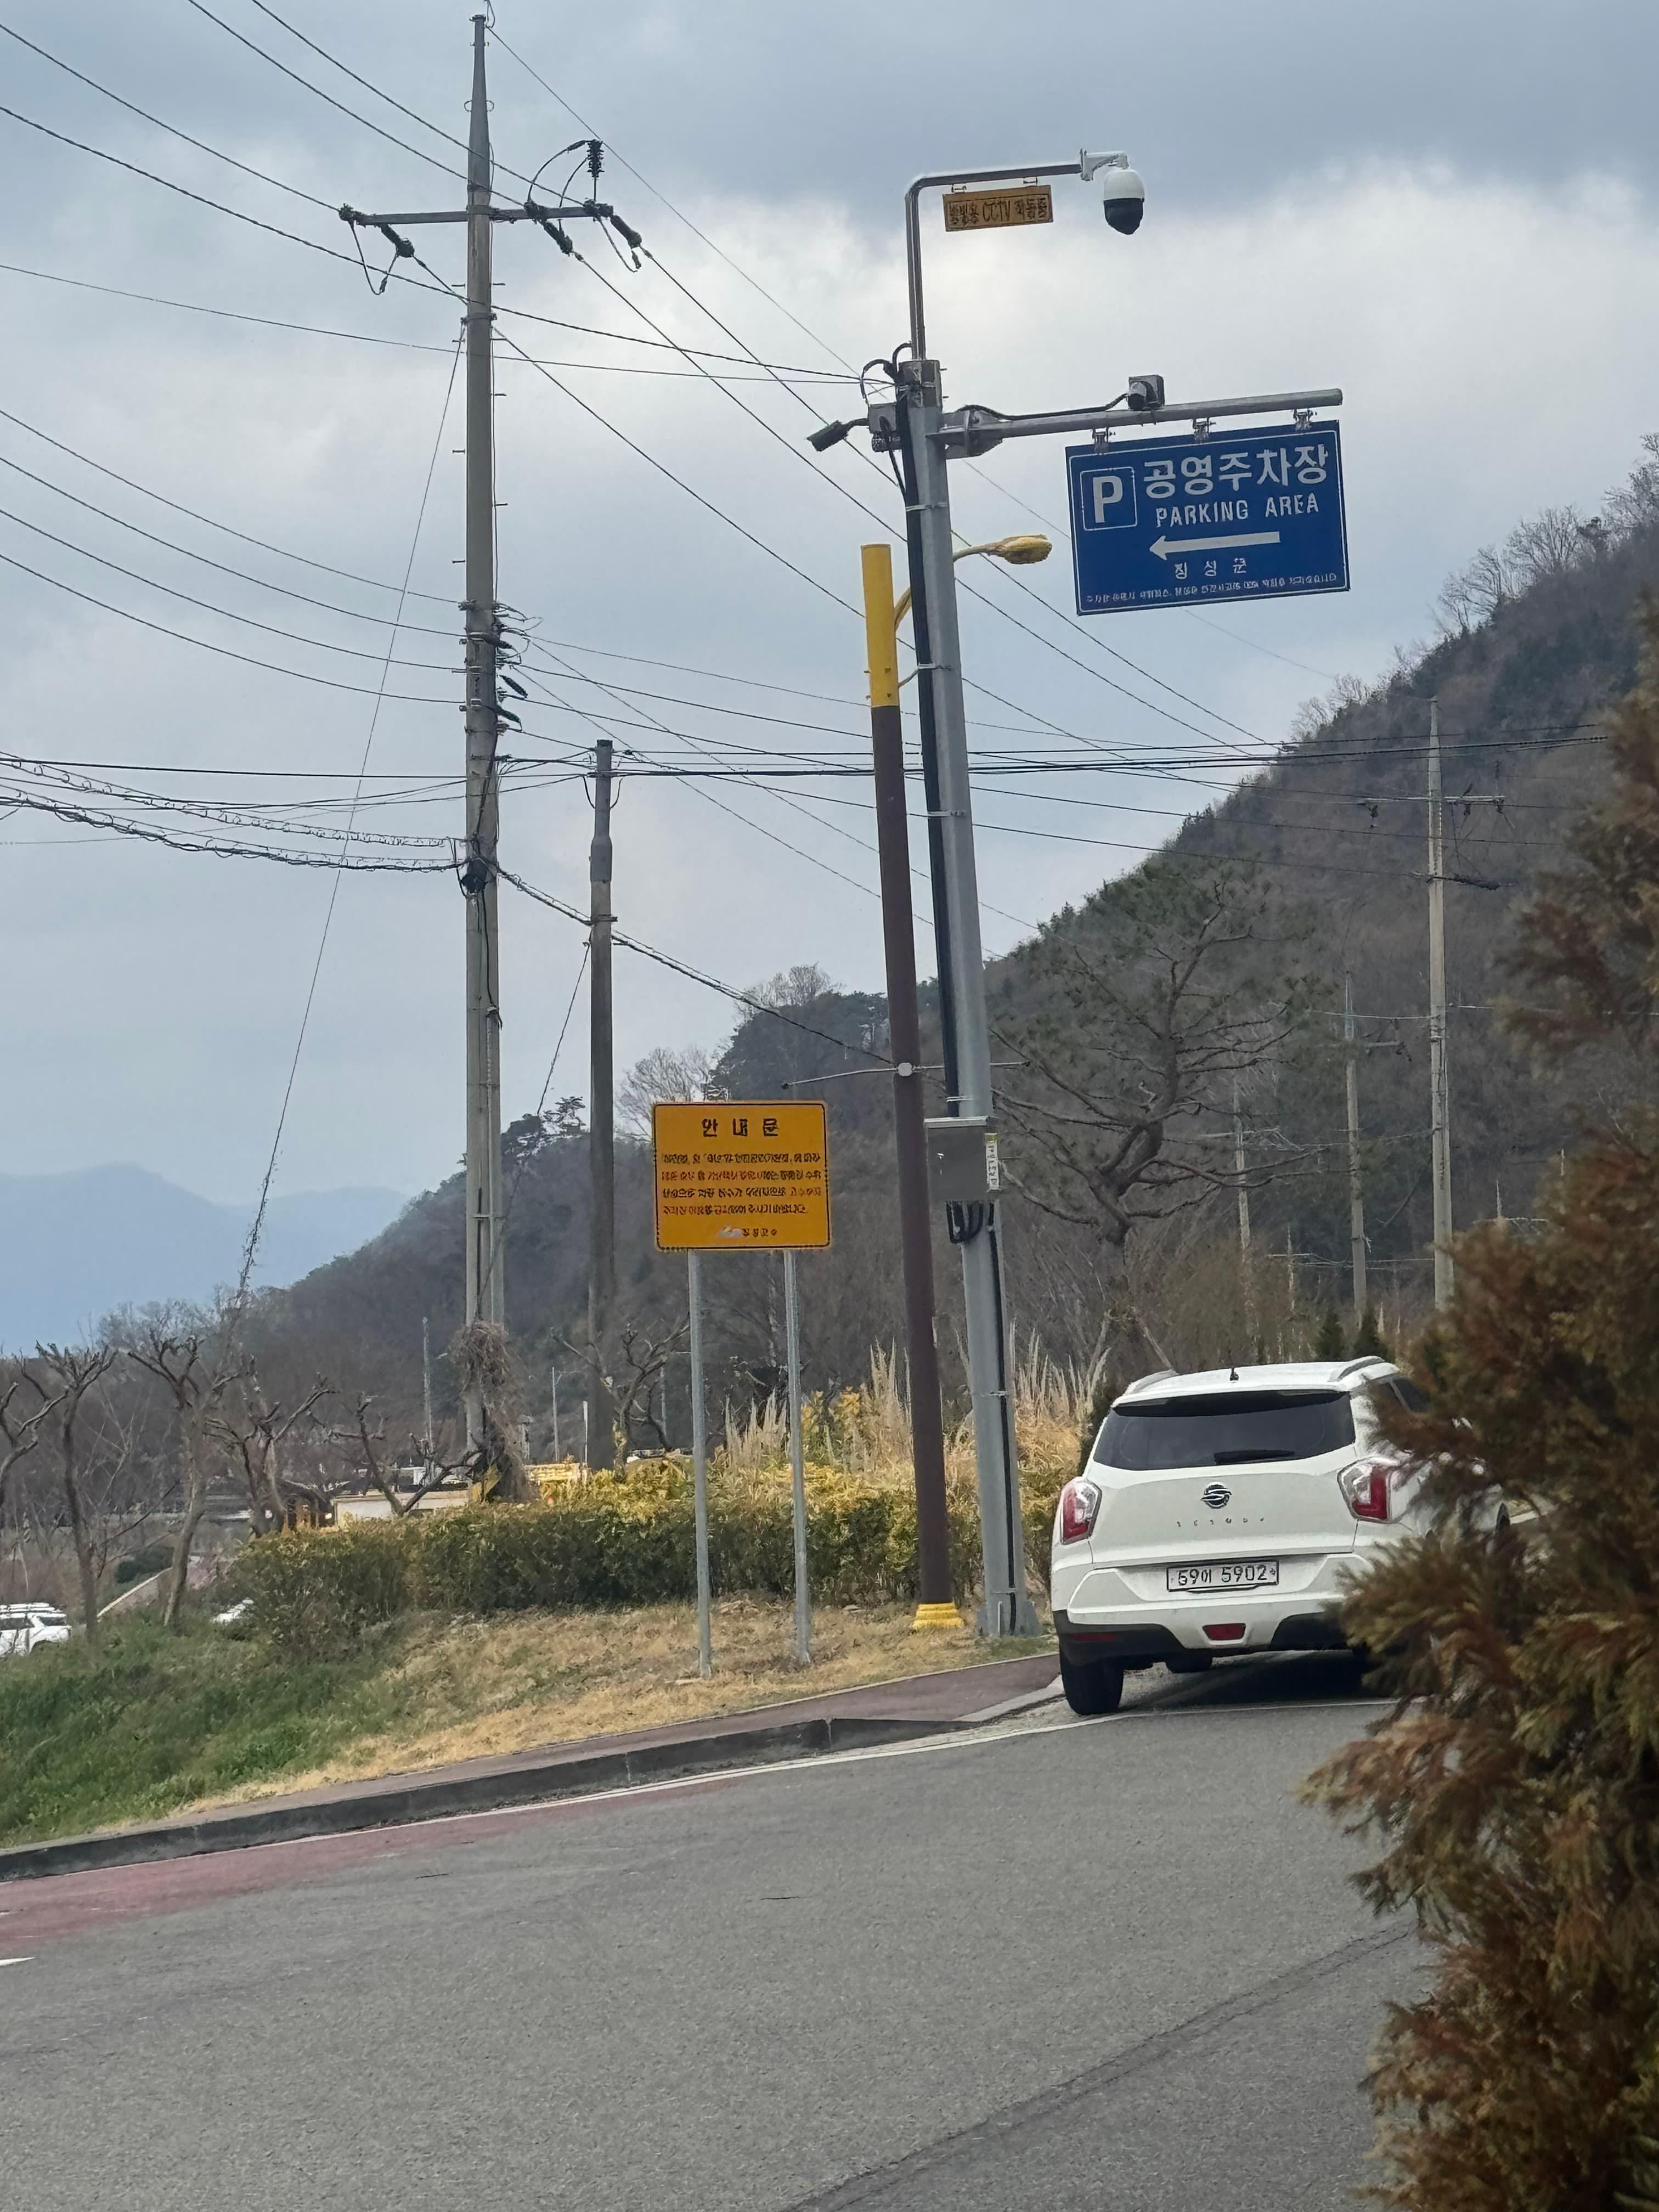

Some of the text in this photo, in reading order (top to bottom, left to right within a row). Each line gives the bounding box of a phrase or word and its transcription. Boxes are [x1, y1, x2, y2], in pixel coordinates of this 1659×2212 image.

[1143, 443, 1329, 500] 공영주차장
[1092, 476, 1124, 523] P
[1155, 493, 1319, 528] PARKING AREA
[1221, 1565, 1267, 1583] 5902
